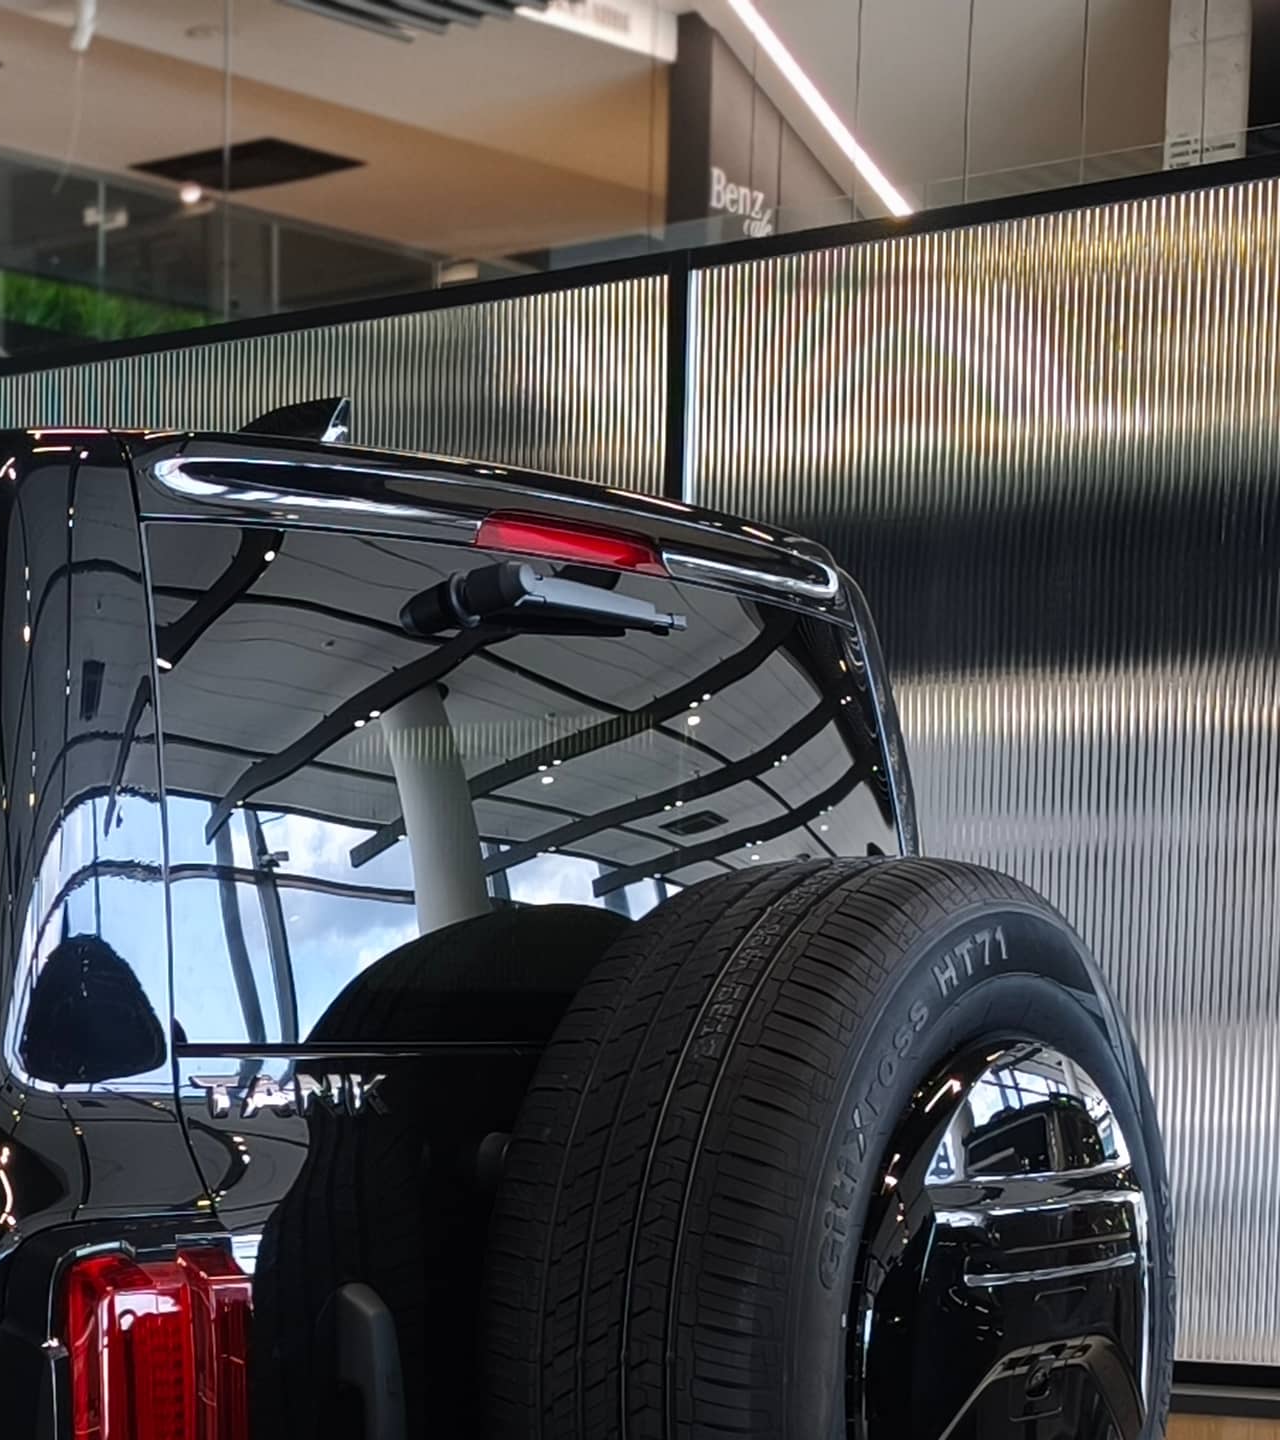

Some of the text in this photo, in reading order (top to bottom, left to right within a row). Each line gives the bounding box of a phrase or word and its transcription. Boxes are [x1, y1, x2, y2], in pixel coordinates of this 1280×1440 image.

[710, 166, 764, 219] Benz
[931, 926, 1010, 1000] HT71
[190, 1073, 391, 1120] TANK
